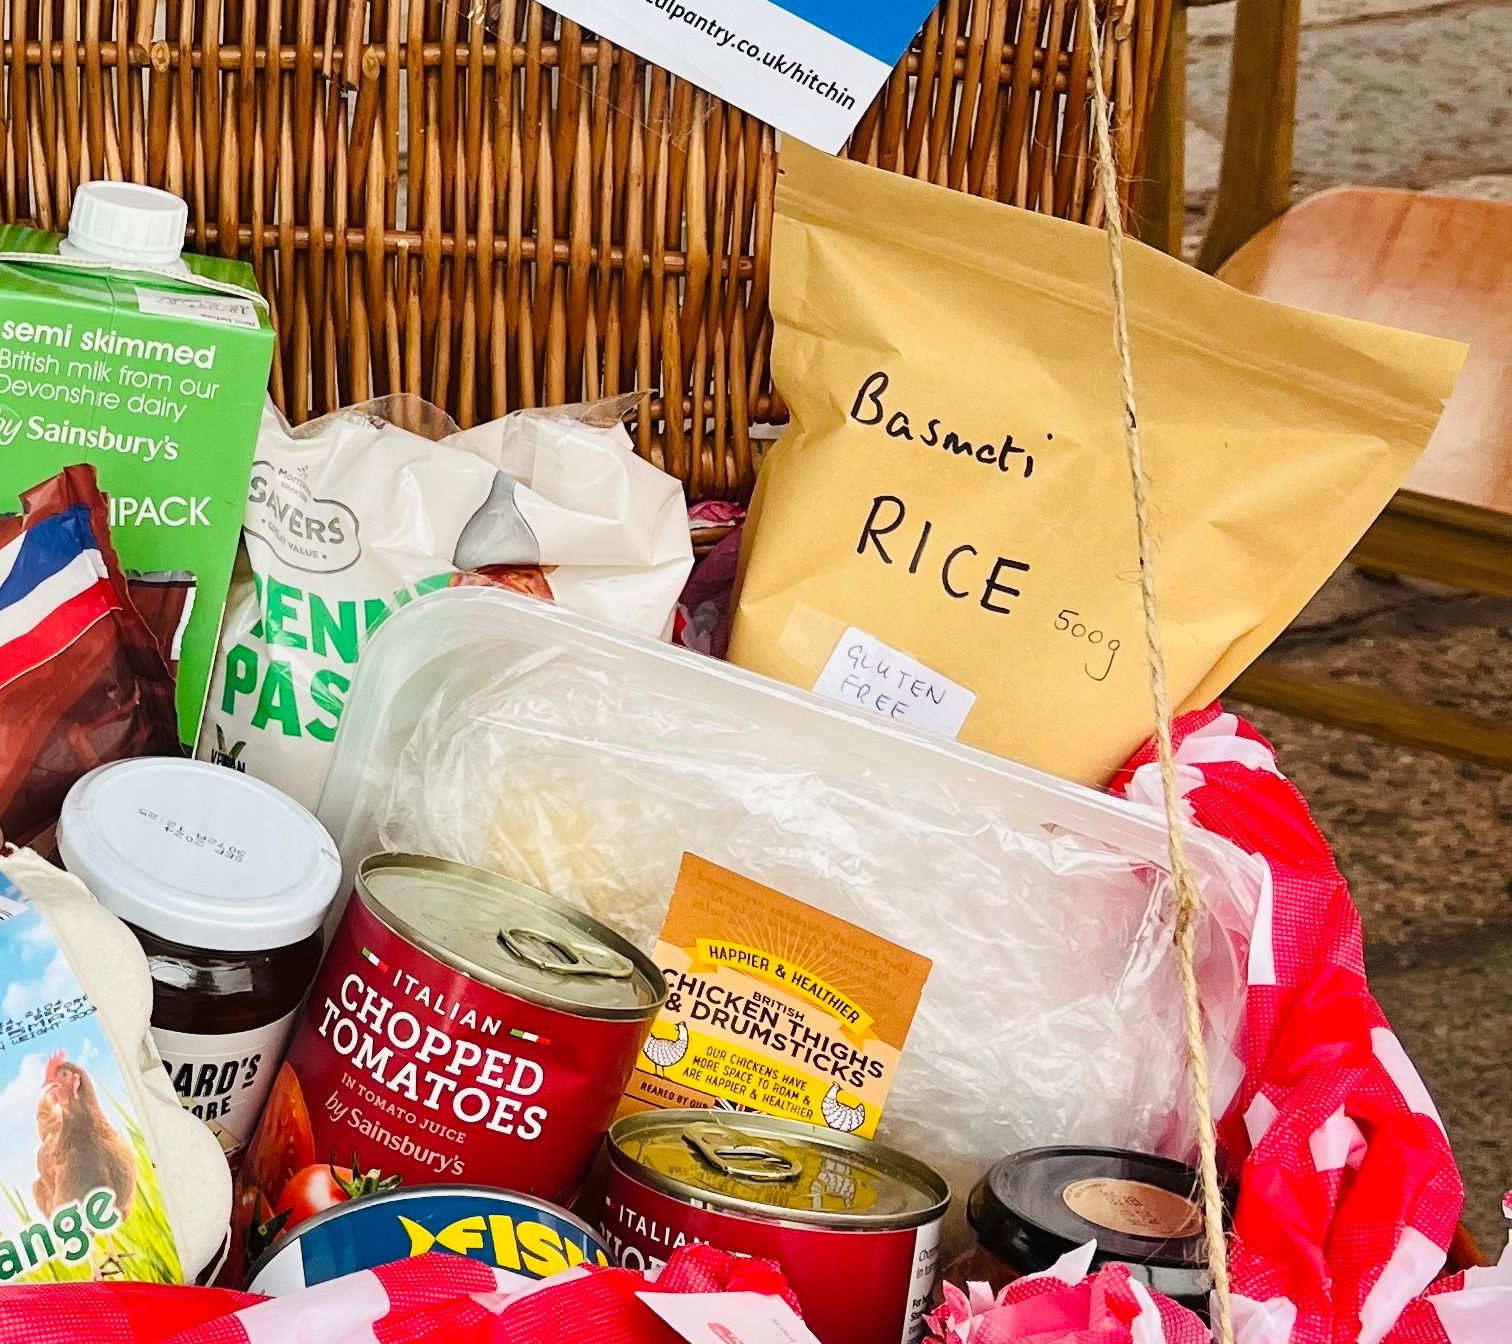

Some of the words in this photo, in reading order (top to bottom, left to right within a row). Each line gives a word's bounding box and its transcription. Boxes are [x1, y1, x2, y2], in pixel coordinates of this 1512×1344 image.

[1, 320, 73, 349] semi
[79, 327, 216, 370] skimmed
[66, 360, 111, 384] milk
[118, 365, 172, 392] from
[179, 378, 220, 399] our
[127, 393, 188, 424] dairy
[26, 415, 179, 463] Sainsbury's
[850, 372, 1055, 479] Basmati
[109, 496, 211, 527] IPACK
[248, 476, 345, 544] SAVERS
[288, 542, 319, 560] VALUE
[856, 495, 1030, 614] RICE
[845, 644, 948, 706] GLUTEN
[1053, 608, 1122, 682] 500g
[221, 643, 351, 742] PAS
[840, 673, 909, 719] FREE
[392, 969, 503, 1036] ITALIAN
[709, 945, 770, 972] HAPPIER
[775, 962, 787, 979] &
[792, 972, 860, 1024] HEALTHIER
[752, 991, 806, 1022] BRITISH
[340, 973, 544, 1096] CHOPPED
[662, 968, 779, 1029] CHICKEN
[789, 1020, 885, 1079] THIGHS
[663, 992, 682, 1013] &
[690, 1001, 866, 1088] DRUMSTICKS
[318, 998, 548, 1141] TOMATOES
[640, 1081, 675, 1100] REARED
[677, 1092, 689, 1104] BY
[682, 1067, 701, 1080] ARE
[704, 1075, 746, 1096] HAPPIER
[749, 1088, 759, 1101] &
[762, 1092, 813, 1119] HEALTHIER
[692, 1056, 719, 1072] MORE
[723, 1063, 753, 1084] SPACE
[758, 1076, 771, 1089] TO
[772, 1082, 799, 1099] ROAM
[802, 1093, 811, 1105] &
[706, 1046, 728, 1061] OUR
[729, 1054, 779, 1080] CHICKENS
[782, 1073, 807, 1091] HAVE
[324, 1090, 349, 1123] by
[347, 1108, 466, 1176] Sainsbury's
[341, 1072, 357, 1090] IN
[358, 1085, 417, 1124] TOMATO
[420, 1119, 467, 1144] JUICE
[619, 1205, 709, 1249] ITALIA
